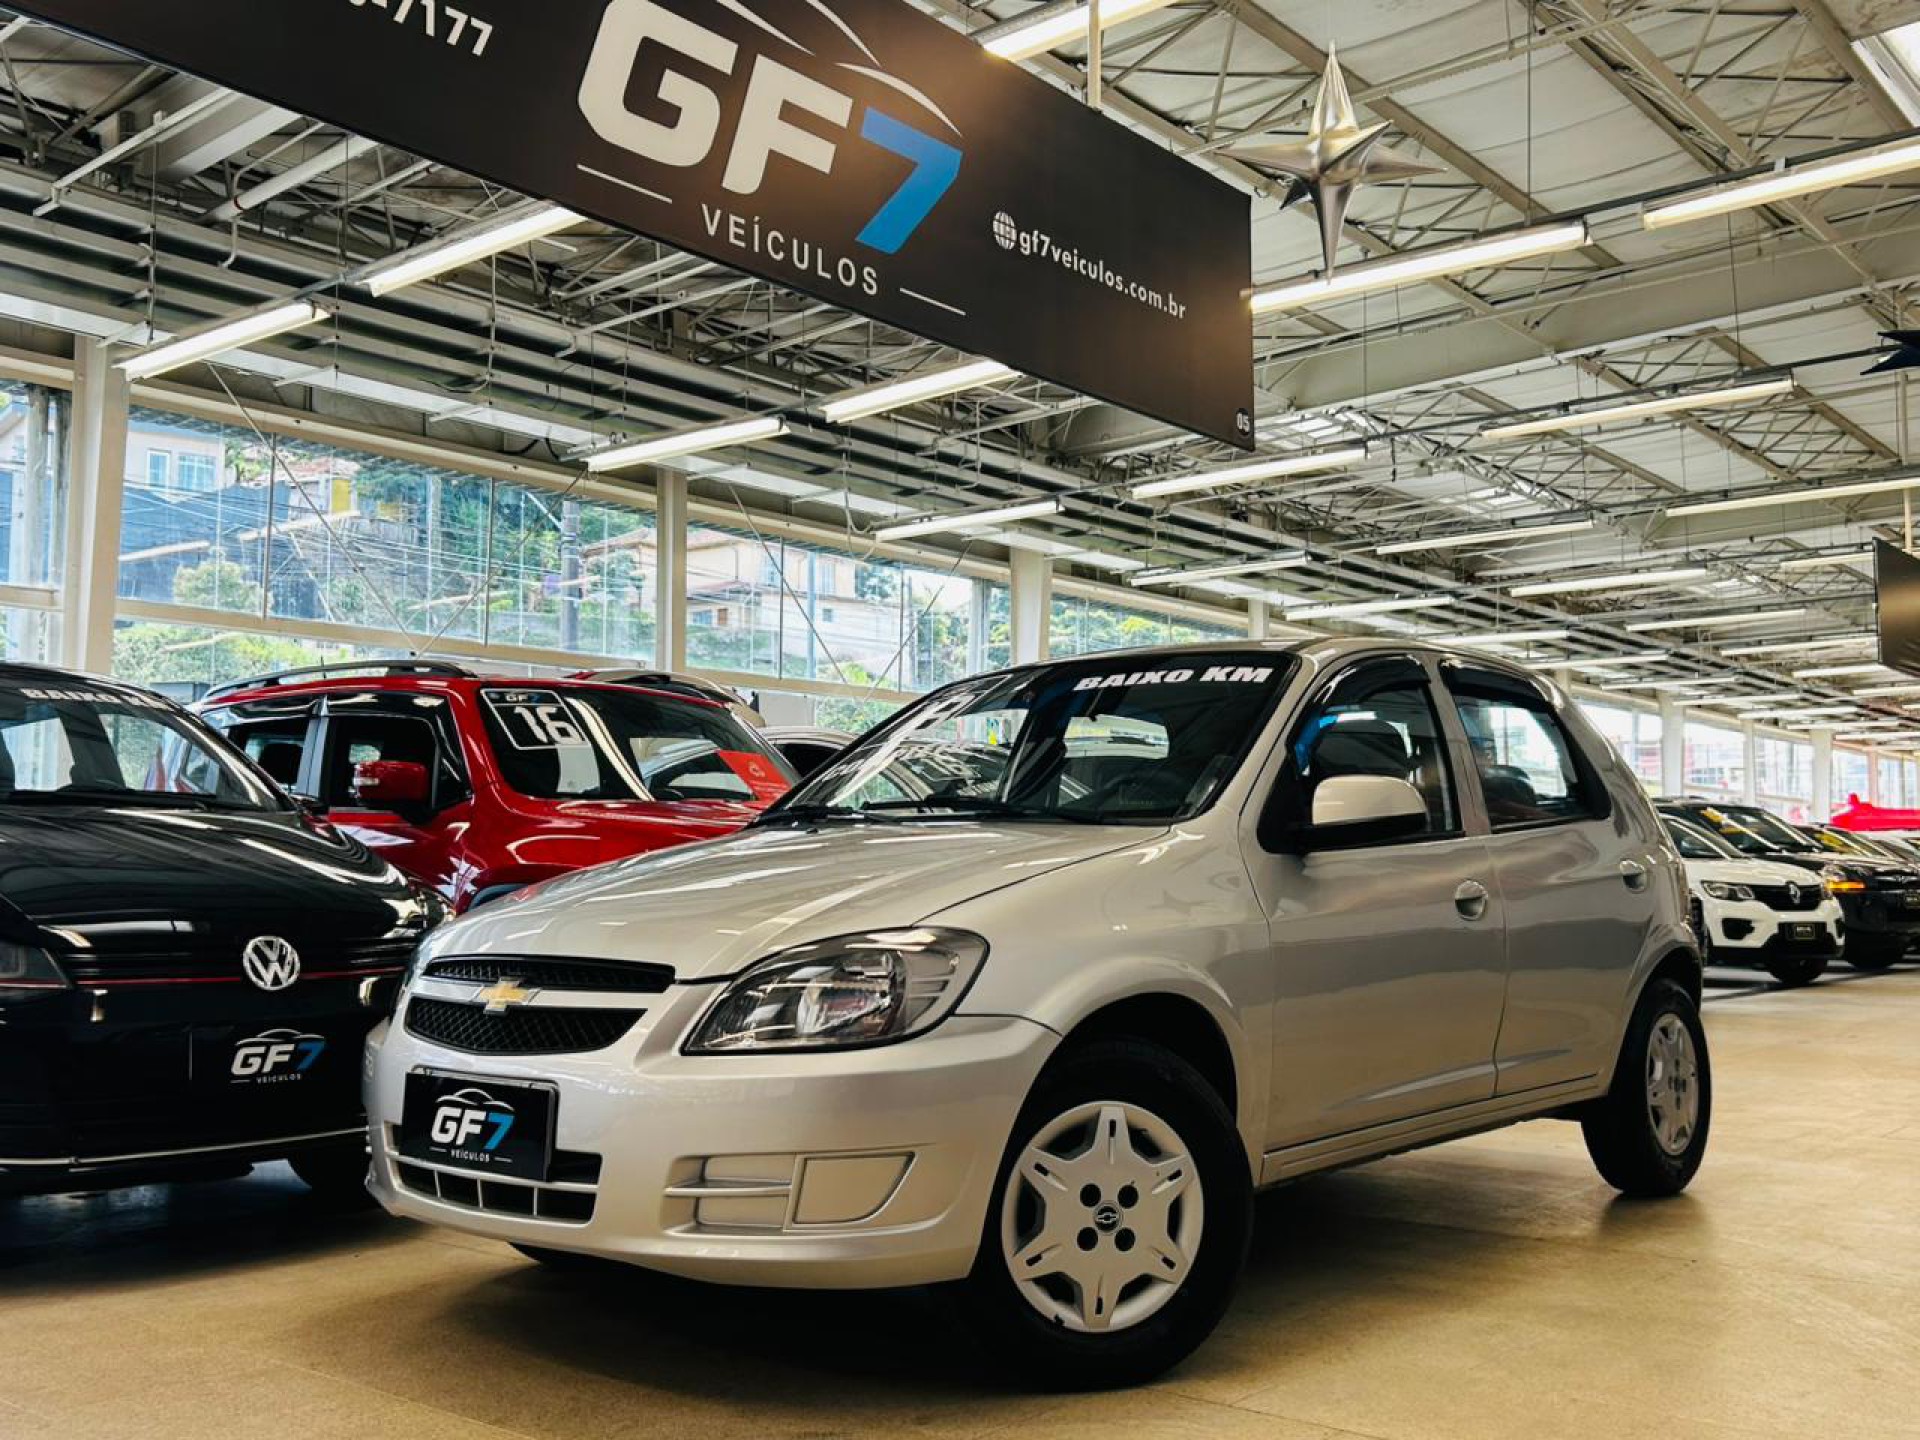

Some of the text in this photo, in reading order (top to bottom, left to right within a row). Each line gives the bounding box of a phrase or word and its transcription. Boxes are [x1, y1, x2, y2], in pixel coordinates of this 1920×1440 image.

[577, 0, 963, 255] GF7
[701, 203, 879, 296] VEÍCULOS
[1019, 229, 1187, 319] gf7veiculos.com.br
[1236, 413, 1250, 432] 05
[1072, 665, 1274, 691] BAIXO KM
[513, 706, 582, 744] 16
[231, 1041, 325, 1075] GF7
[431, 1106, 515, 1150] GF7
